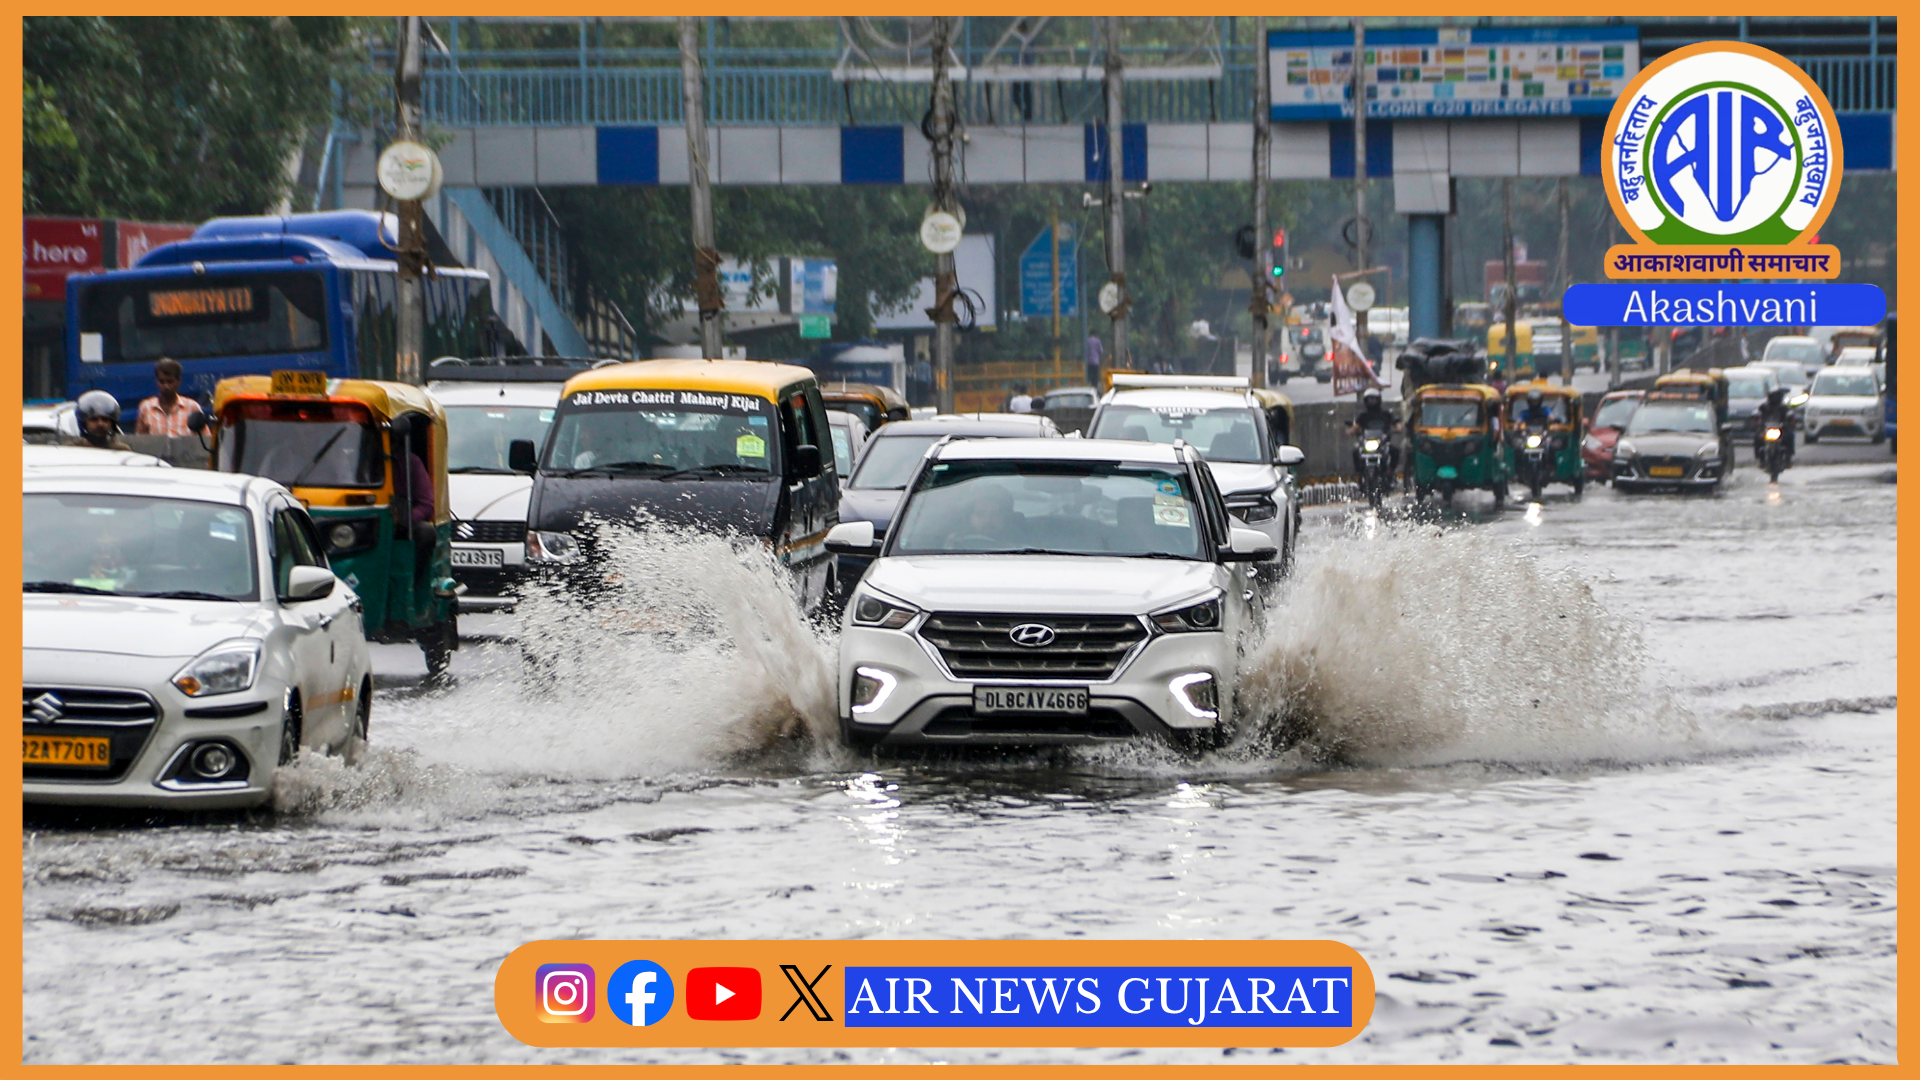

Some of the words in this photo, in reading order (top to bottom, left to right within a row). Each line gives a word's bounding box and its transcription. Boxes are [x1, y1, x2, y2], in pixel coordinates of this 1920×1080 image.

[1340, 100, 1423, 117] WLCOME
[1432, 99, 1466, 116] G20
[1470, 98, 1573, 115] DELEGATES
[32, 239, 89, 264] here
[572, 393, 593, 406] Jai
[594, 391, 630, 405] Devta
[631, 391, 676, 405] Chattri
[730, 395, 761, 412] Kijai
[985, 691, 1086, 709] DL8CAV4666
